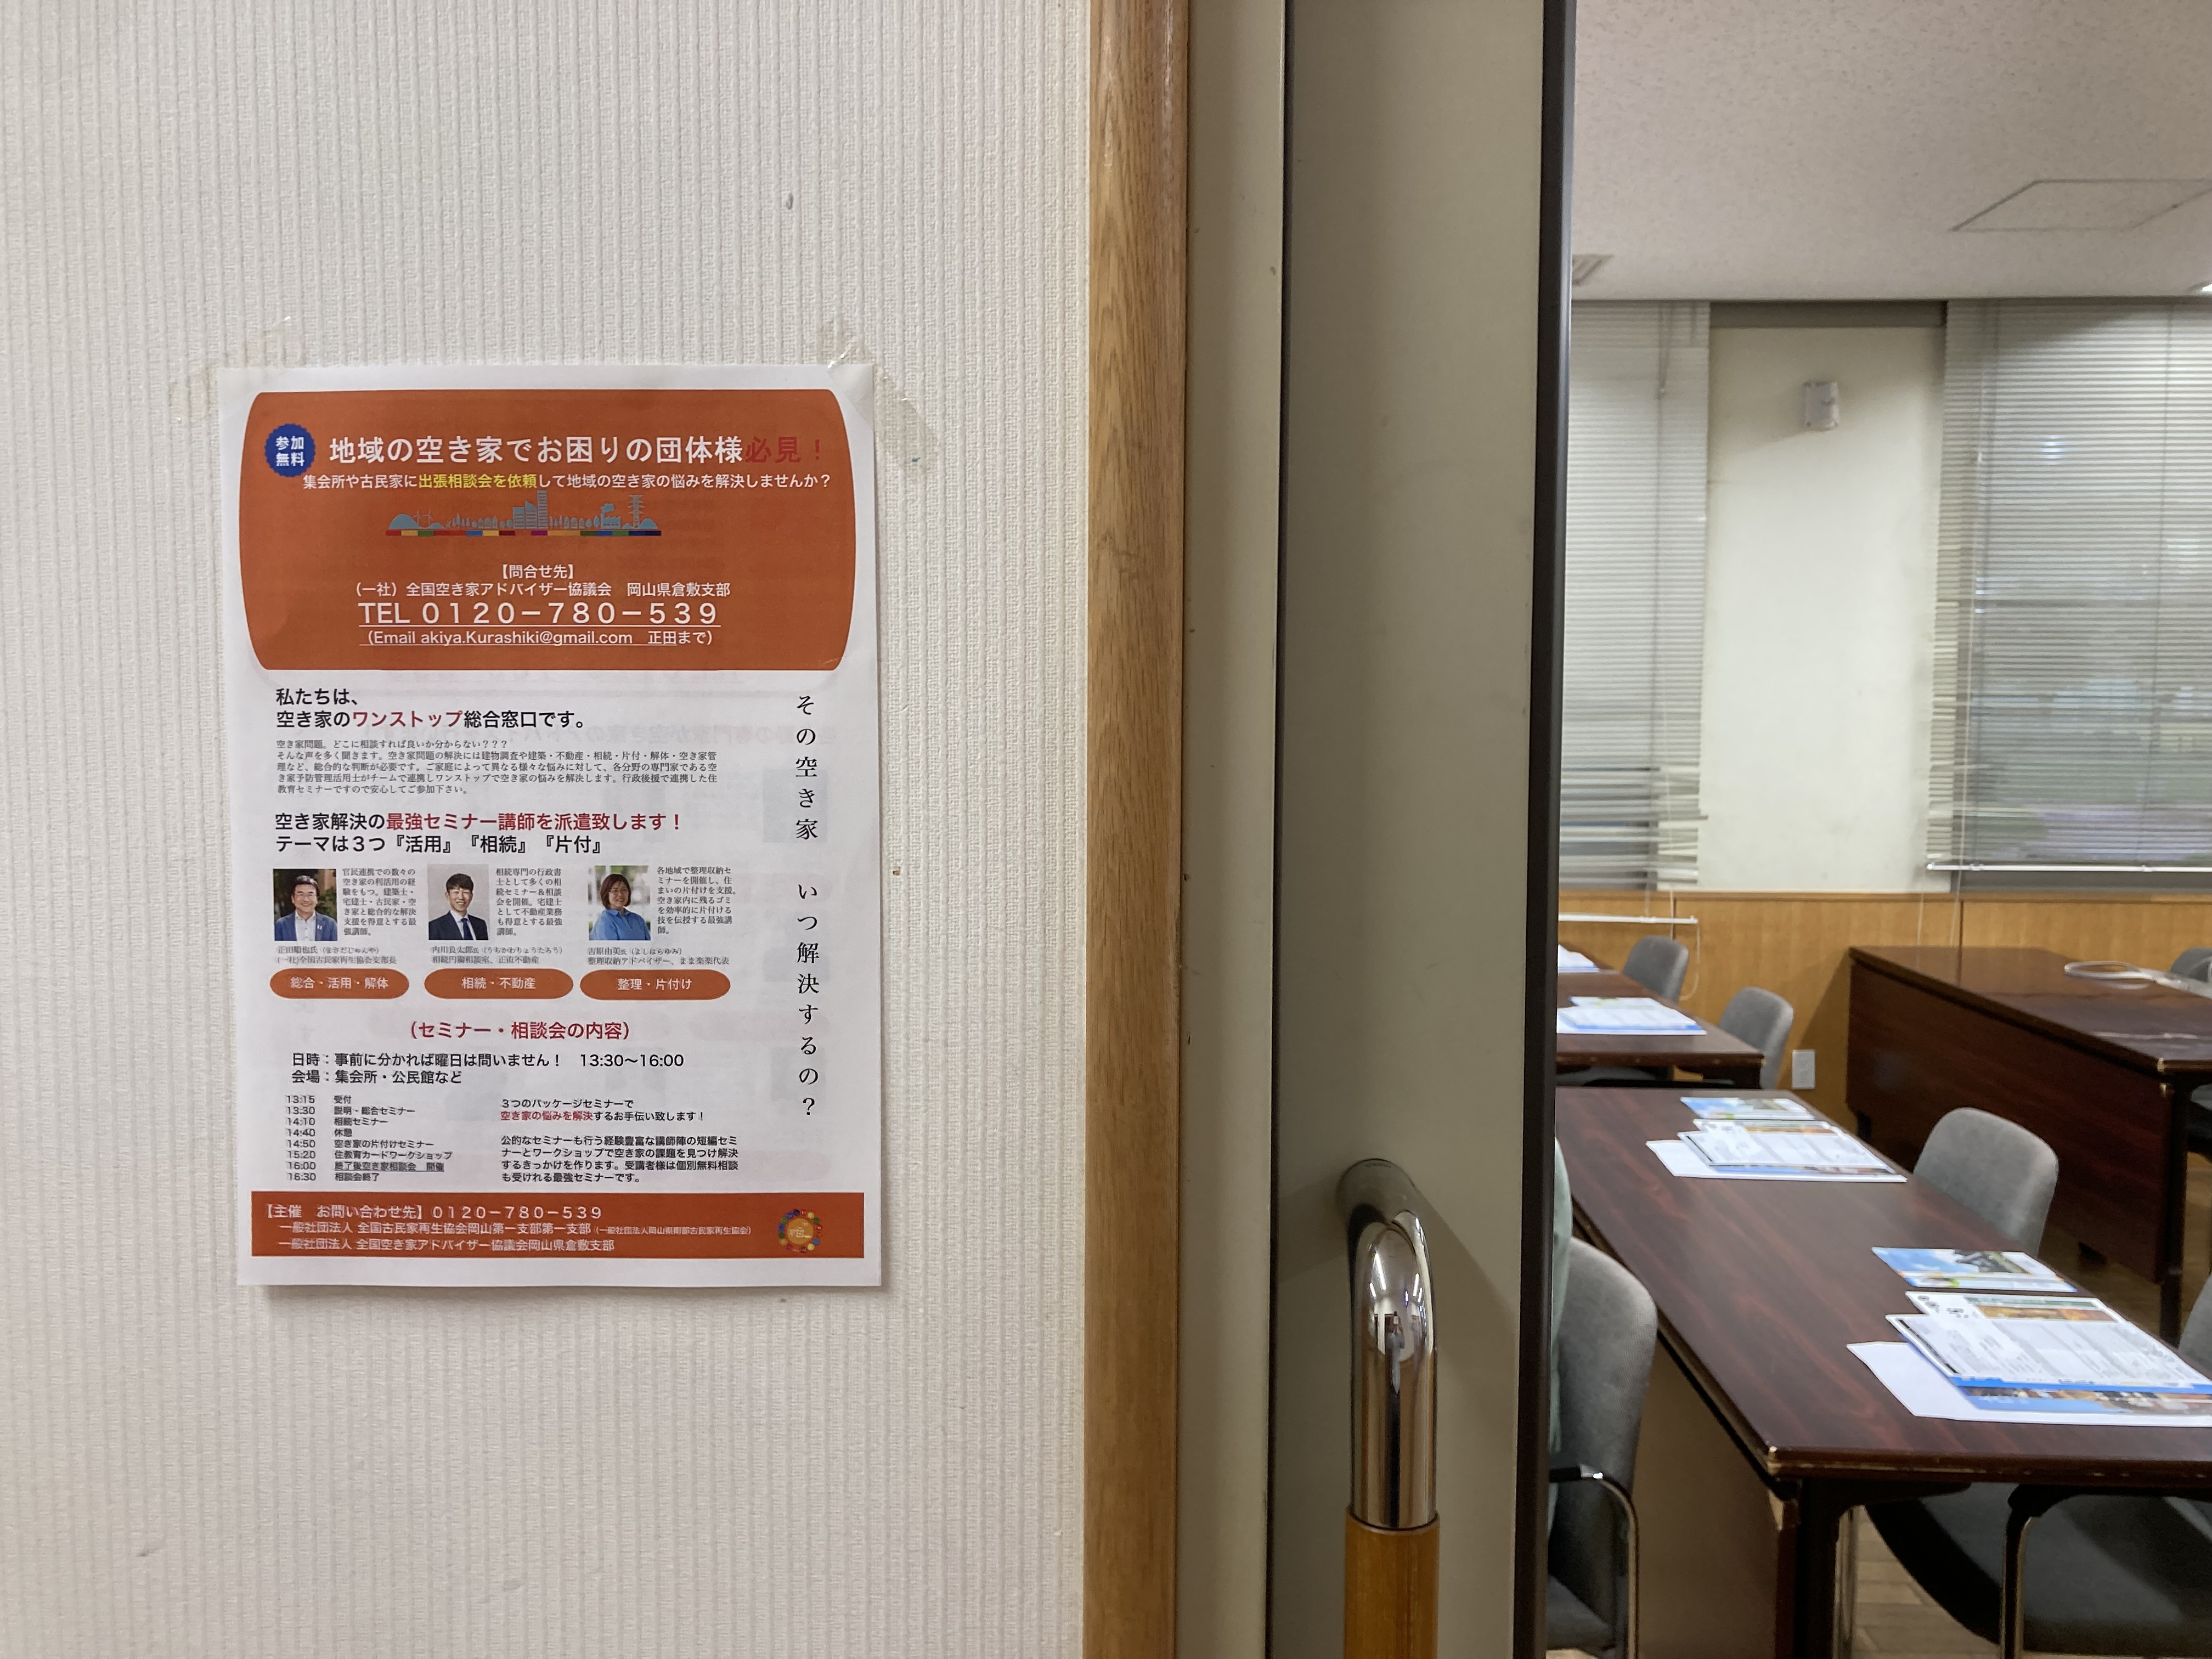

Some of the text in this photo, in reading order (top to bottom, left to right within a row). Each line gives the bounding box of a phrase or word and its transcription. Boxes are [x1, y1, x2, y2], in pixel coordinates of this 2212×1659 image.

[276, 436, 304, 450] 参加
[329, 435, 821, 464] 地域の空き家でお困りの団体様必見！
[276, 452, 304, 466] 無料
[303, 474, 830, 489] 集会所や古民家に出張相談会を依頼して地域の空き家の悩みを解決しませんか？
[503, 565, 573, 579] 【問合せ先】
[628, 582, 730, 596] 岡山県倉敷支部
[358, 603, 410, 623] TEL
[419, 631, 634, 646] akiya.Kurashiki@gmail.com
[276, 689, 357, 706] 私たちは、
[277, 710, 583, 728] 空き家のワンストップ総合窓口です。
[275, 812, 678, 831] 空き家解決の最強セミナー講師を派遣致します！
[496, 868, 561, 876] 相続専門の行政書
[496, 878, 561, 886] 士として多くの相
[796, 696, 819, 1115] その空き家 いつ解決するの？
[291, 977, 388, 989] 総合・活用・解体
[462, 977, 535, 989] 相続・不動産
[618, 978, 691, 990] 整理・片付け
[292, 1070, 461, 1084] 会場：集会所・公民館など
[287, 1095, 351, 1104] 13:15 受付
[334, 1117, 387, 1126] 相続セミナー
[288, 1128, 352, 1137] 14:40 休憩
[287, 1139, 434, 1148] 14:50 空き家の片付けセミナー
[288, 1150, 315, 1159] 15:20
[425, 1161, 445, 1171] 開催
[335, 1172, 379, 1181] 相談会終了
[280, 1221, 353, 1233] 一般社団法人
[279, 1238, 352, 1250] 一般社団法人
